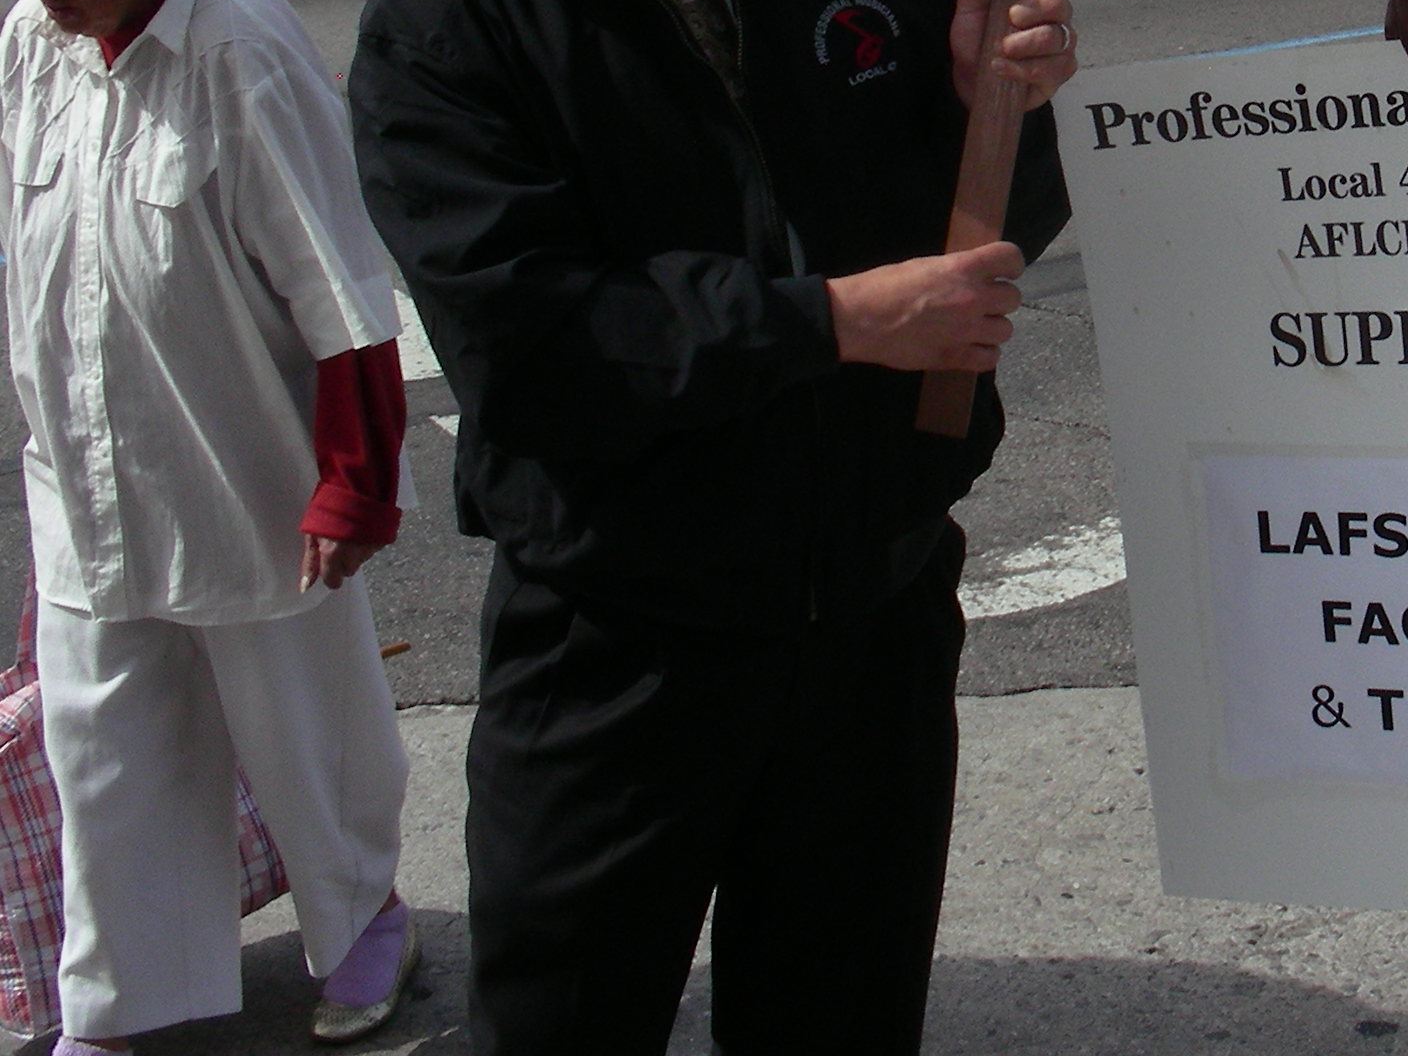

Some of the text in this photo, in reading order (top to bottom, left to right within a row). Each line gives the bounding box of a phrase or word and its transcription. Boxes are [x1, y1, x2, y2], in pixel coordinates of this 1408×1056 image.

[848, 65, 889, 86] LOCAL
[1277, 162, 1387, 202] Local
[1311, 684, 1352, 729] &
